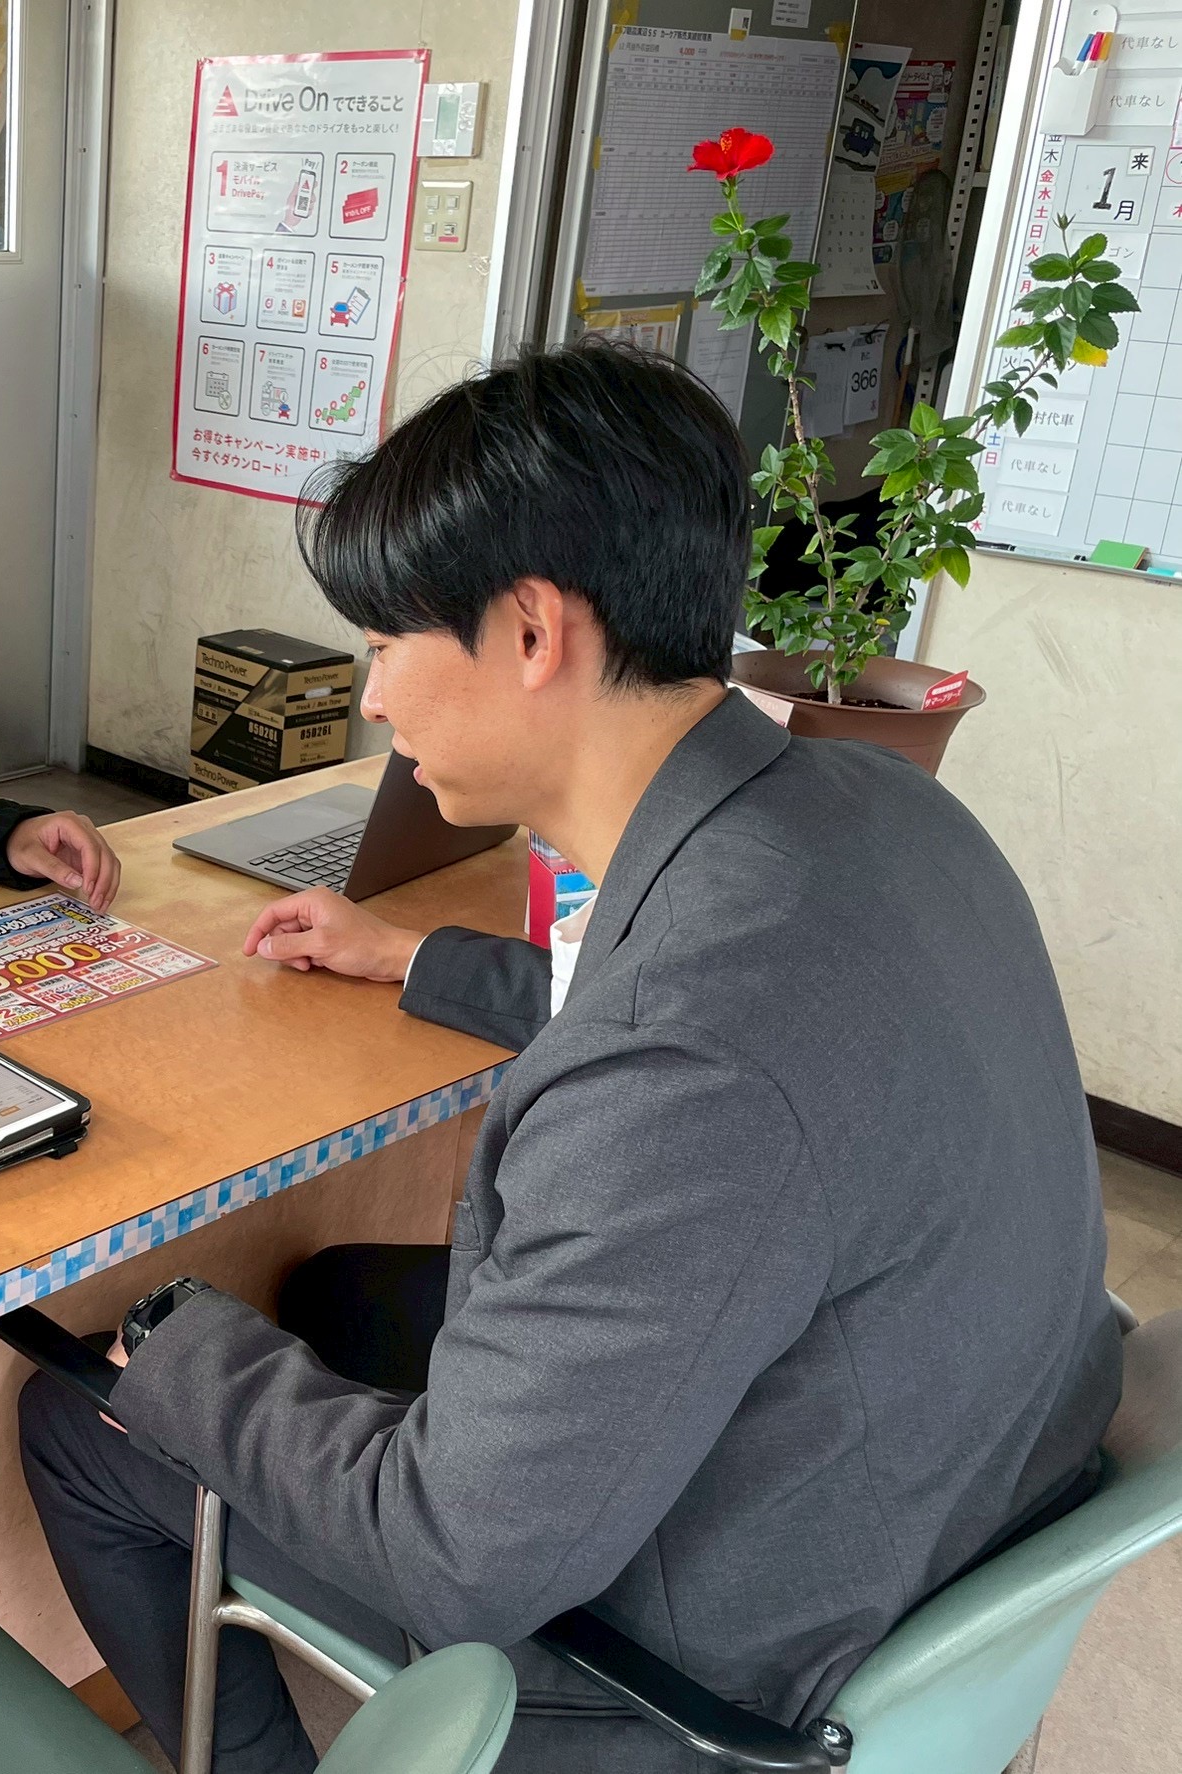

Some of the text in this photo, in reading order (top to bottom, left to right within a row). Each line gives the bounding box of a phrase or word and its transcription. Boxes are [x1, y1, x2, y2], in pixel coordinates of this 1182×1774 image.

[1121, 35, 1179, 50] 代車なし
[244, 86, 404, 113] Drive On でできること
[1110, 94, 1166, 109] 代車なし
[1043, 148, 1059, 163] 木
[1131, 153, 1149, 170] 来
[340, 160, 349, 175] 2
[216, 160, 229, 197] 1
[1039, 169, 1055, 183] 金
[1037, 187, 1052, 201] 水
[1033, 206, 1049, 220] 土
[1113, 200, 1135, 221] 月
[1029, 224, 1042, 239] 日
[1025, 244, 1039, 258] 火
[209, 252, 216, 266] 3
[267, 256, 274, 269] 4
[331, 260, 339, 274] 5
[1020, 280, 1032, 293] 月
[202, 343, 209, 355] 6
[259, 350, 266, 362] 7
[320, 357, 328, 370] 8
[851, 368, 878, 393] 366
[193, 428, 327, 463] お得なキャンペーン実施中!
[986, 433, 1001, 447] 土
[191, 447, 289, 477] 今すぐダウンロード!
[984, 452, 997, 465] 日
[1010, 457, 1062, 476] 代車なし
[1000, 499, 1052, 520] 代車なし
[300, 724, 332, 741] 85D26L
[97, 932, 150, 954] おトク!
